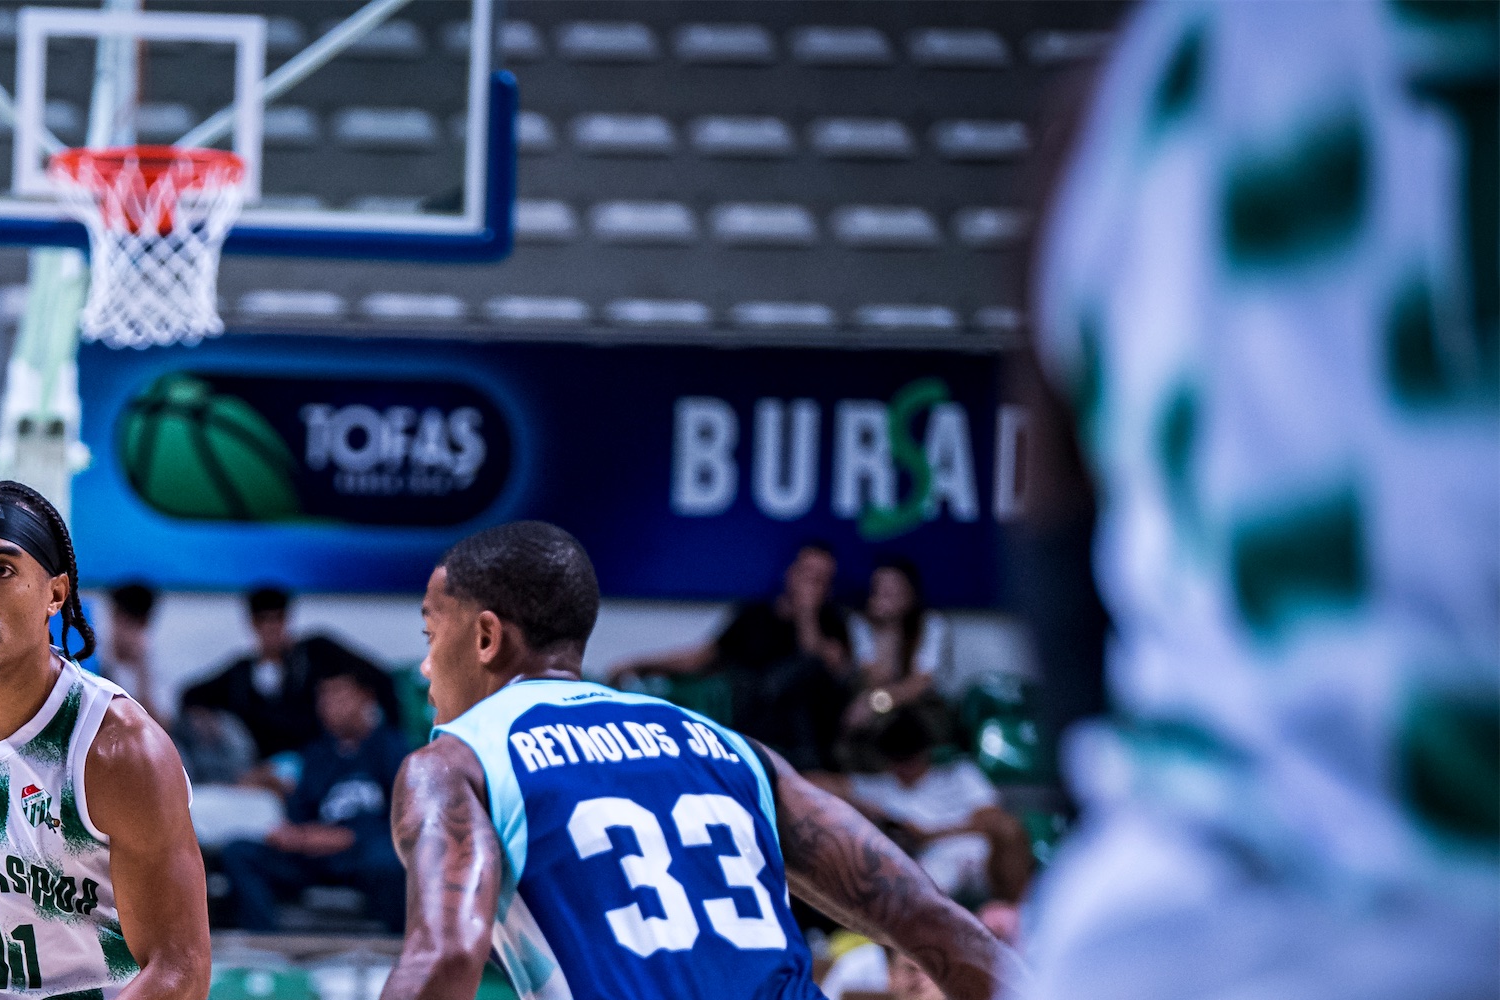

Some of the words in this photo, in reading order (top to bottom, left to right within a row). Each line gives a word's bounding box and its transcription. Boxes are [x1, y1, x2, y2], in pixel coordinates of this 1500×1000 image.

[510, 721, 681, 773] REYNOLDS
[682, 720, 740, 763] JR.
[567, 793, 788, 958] 33
